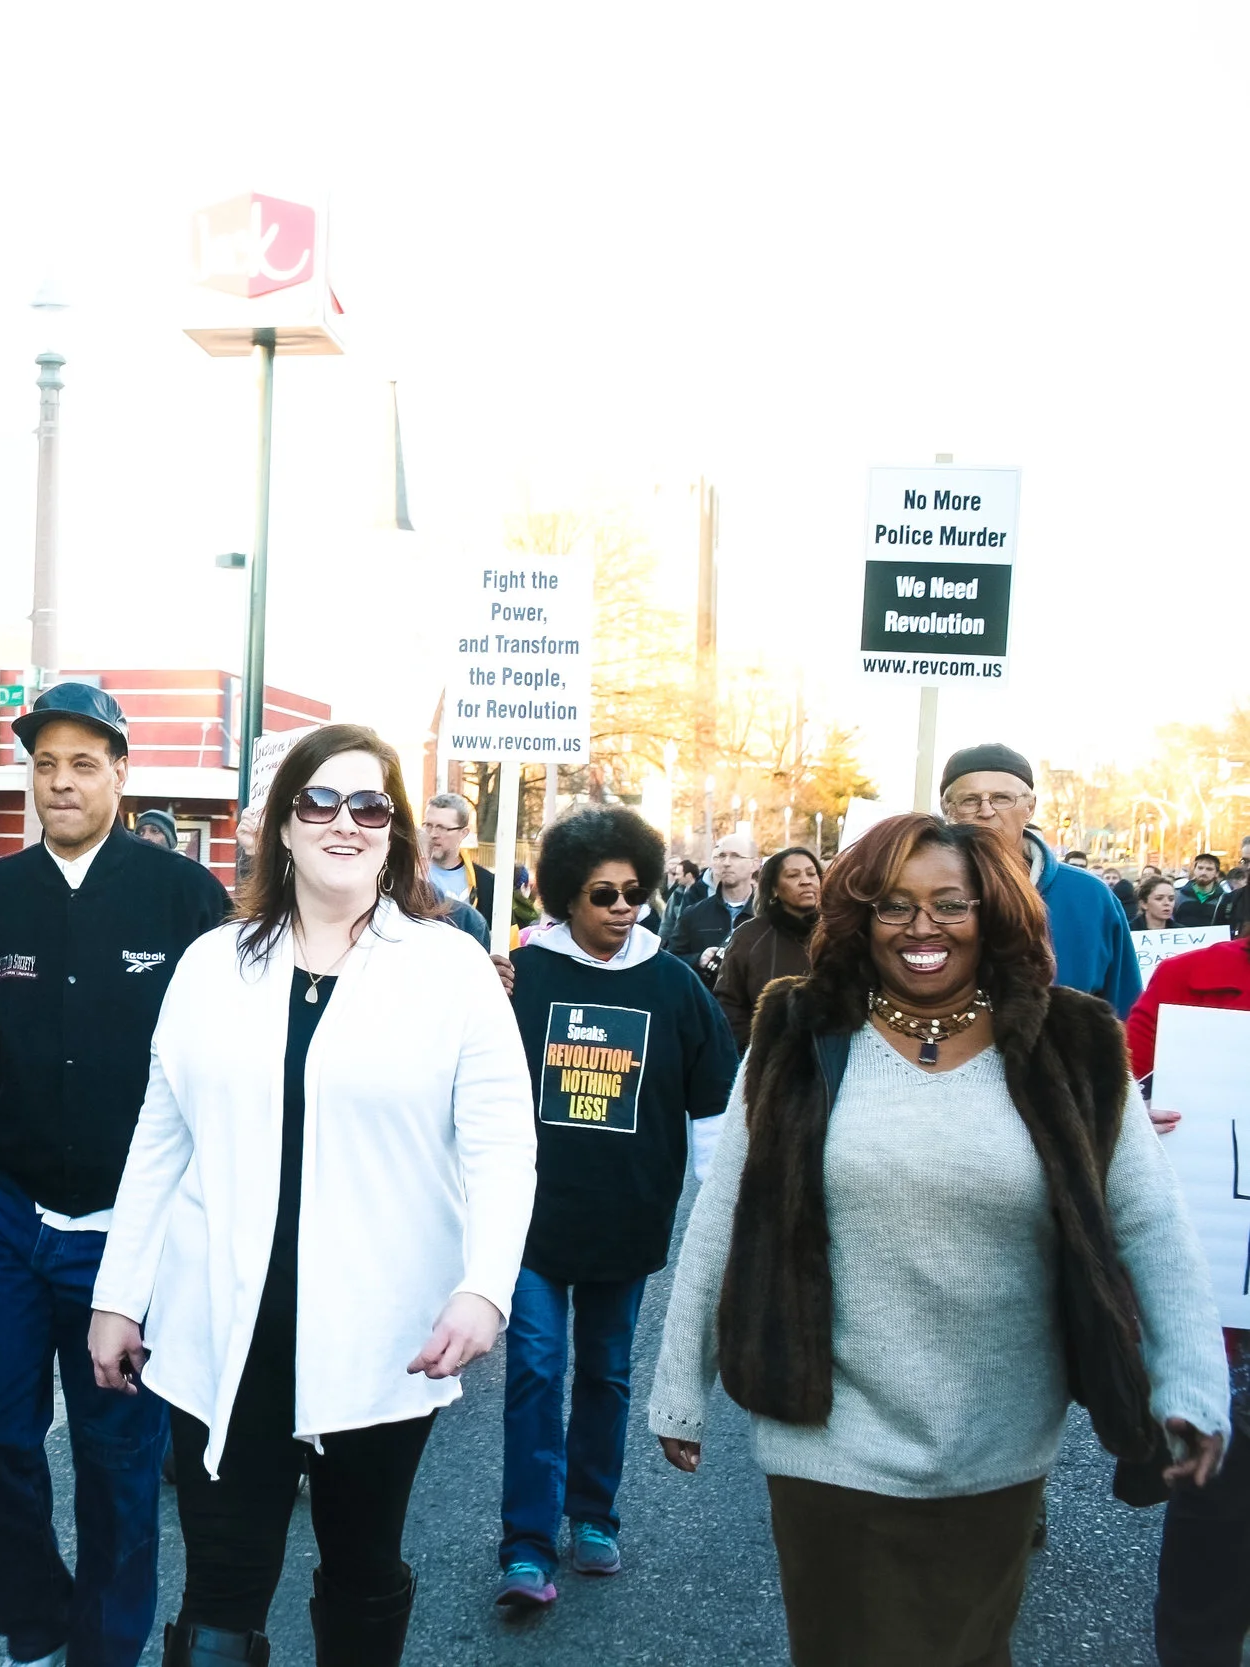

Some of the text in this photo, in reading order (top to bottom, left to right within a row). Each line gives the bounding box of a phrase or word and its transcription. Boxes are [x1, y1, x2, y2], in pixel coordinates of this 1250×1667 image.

[903, 489, 982, 511] No More
[875, 524, 1007, 547] Police Murder
[483, 570, 559, 592] Fight the
[896, 576, 979, 600] We Need
[491, 602, 548, 624] Power,
[884, 610, 985, 635] Revolution
[458, 635, 580, 654] and Transform
[469, 667, 566, 691] the People,
[863, 658, 1003, 678] www.revcom.us
[457, 699, 577, 720] for Revolution
[452, 735, 581, 752] www.revcom.us
[1141, 932, 1206, 946] A FEW
[122, 950, 166, 962] Reebok
[567, 1024, 608, 1041] Speaks:
[560, 1069, 622, 1098] NOTHING
[569, 1095, 608, 1121] LESS!
